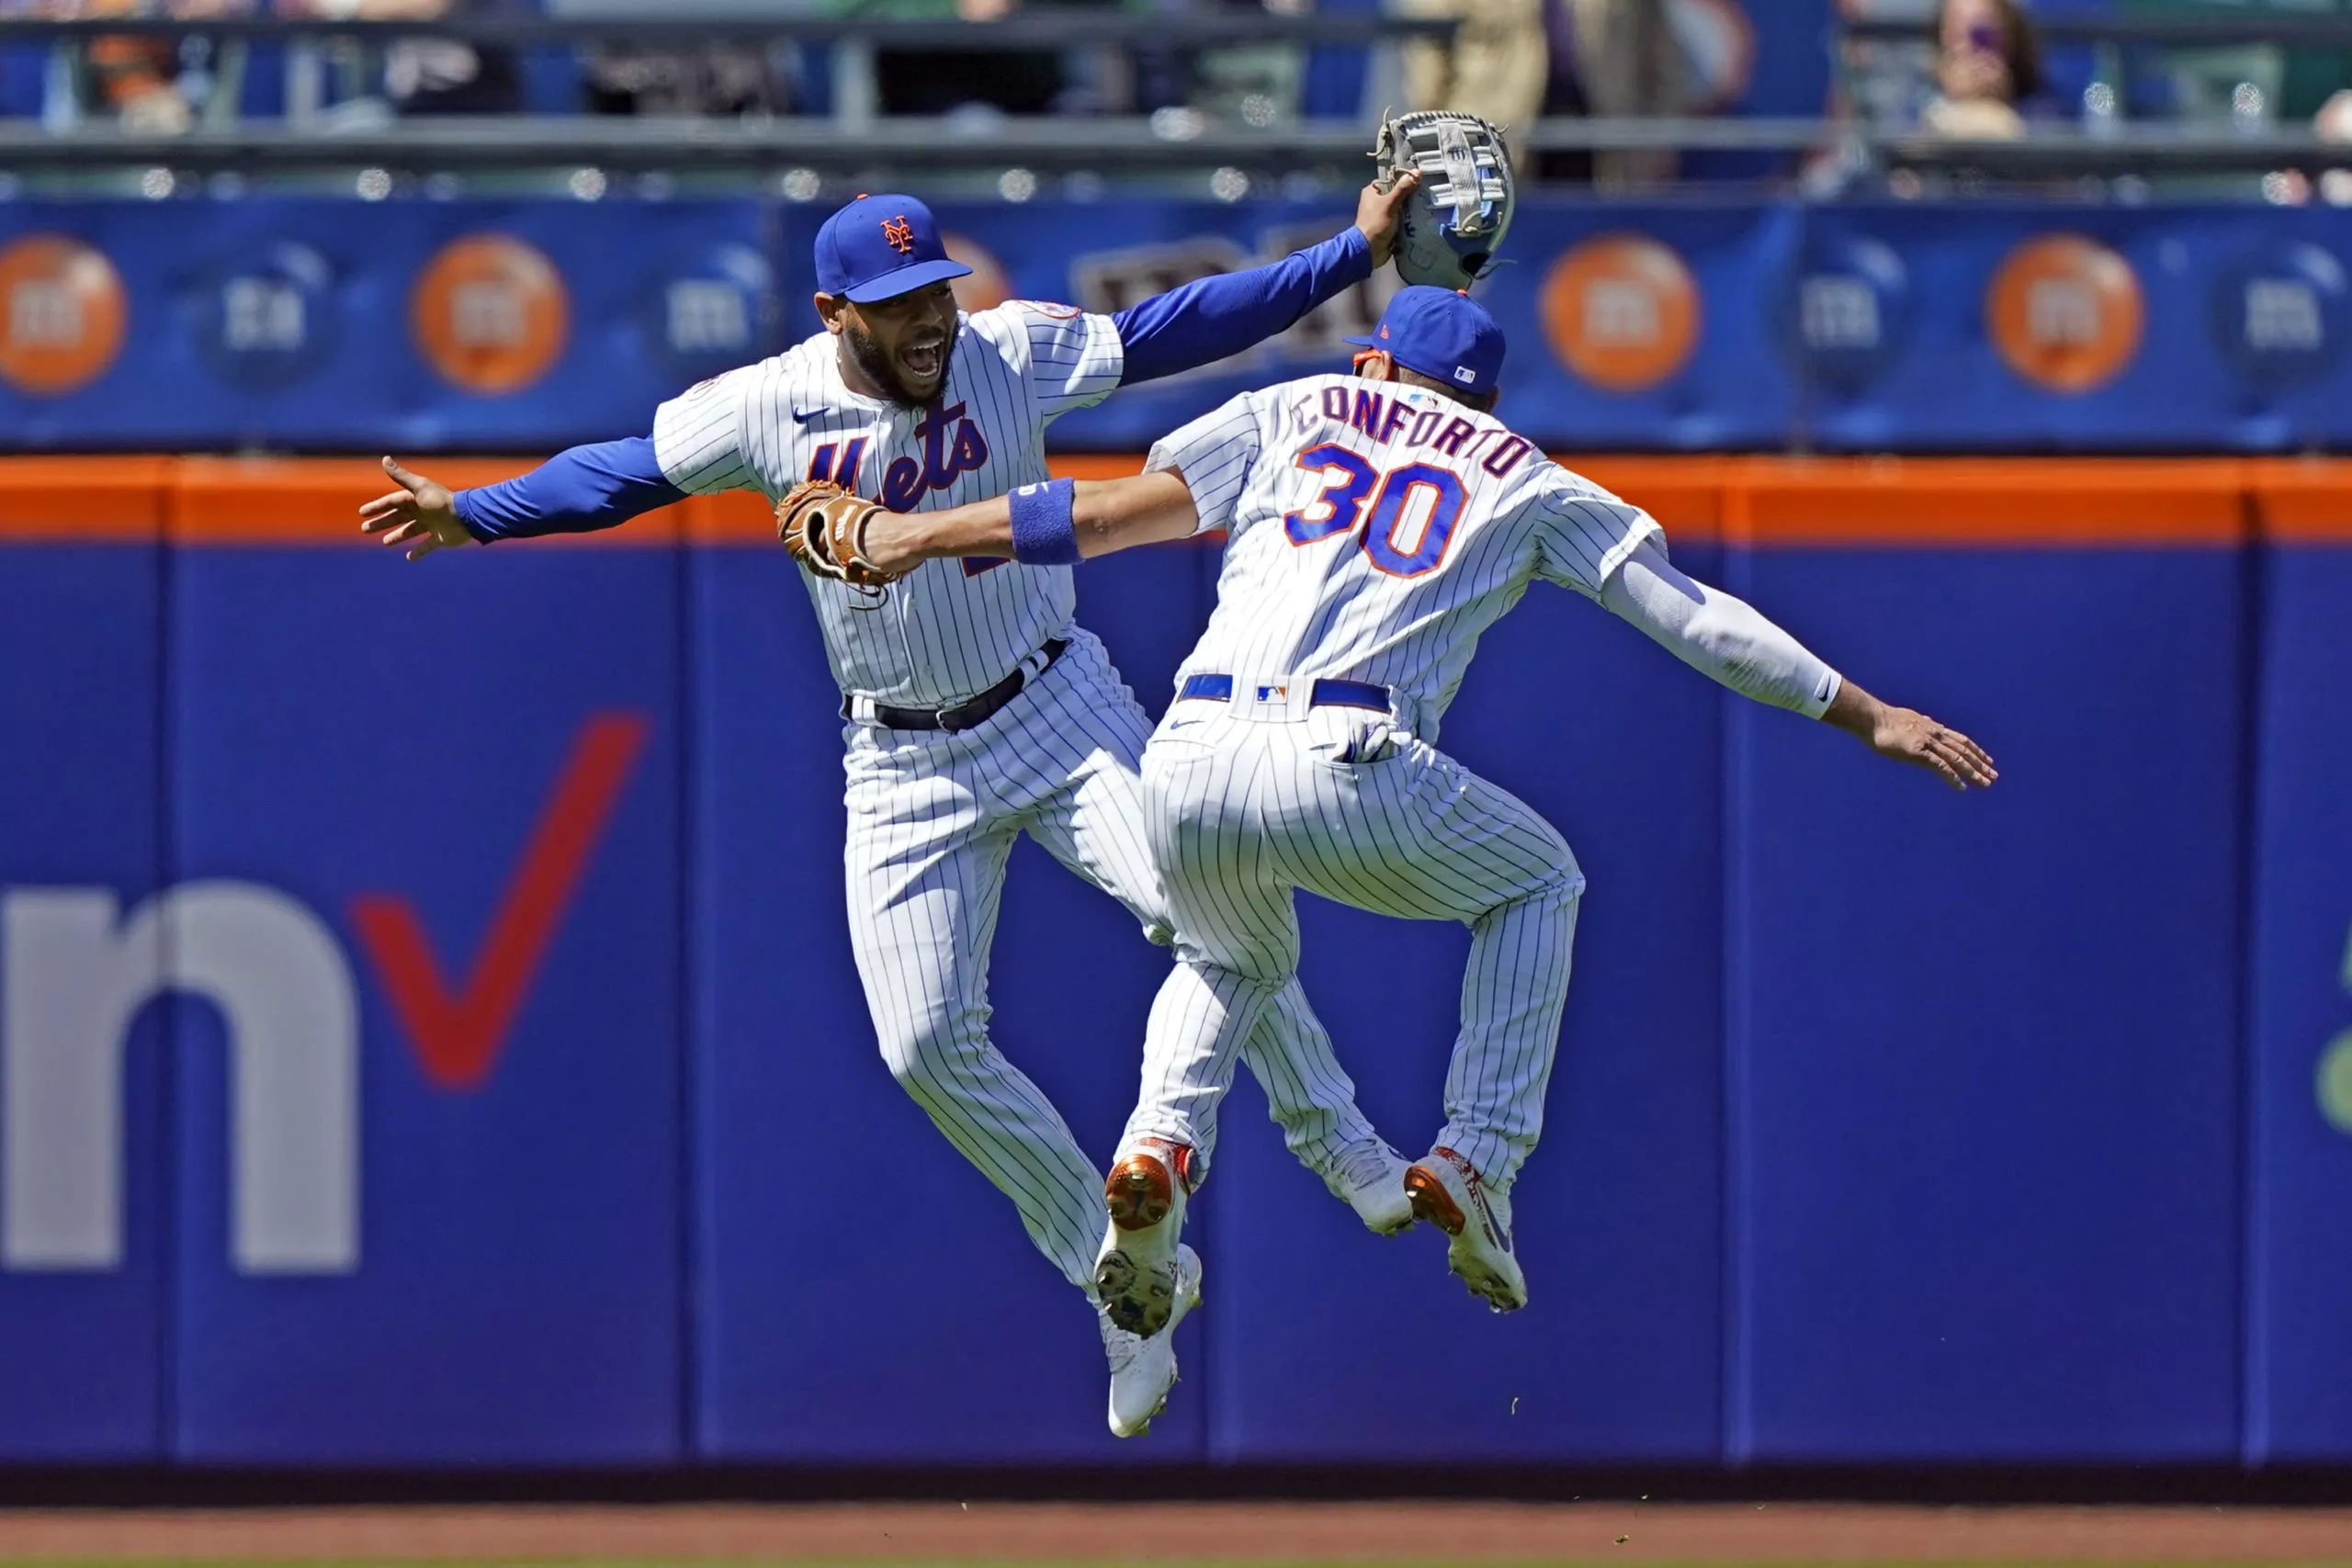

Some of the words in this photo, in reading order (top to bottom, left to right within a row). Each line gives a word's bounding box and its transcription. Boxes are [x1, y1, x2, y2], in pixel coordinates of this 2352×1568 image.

[807, 397, 989, 514] Mets
[1288, 385, 1534, 479] CONFORTO
[1283, 441, 1471, 580] 30
